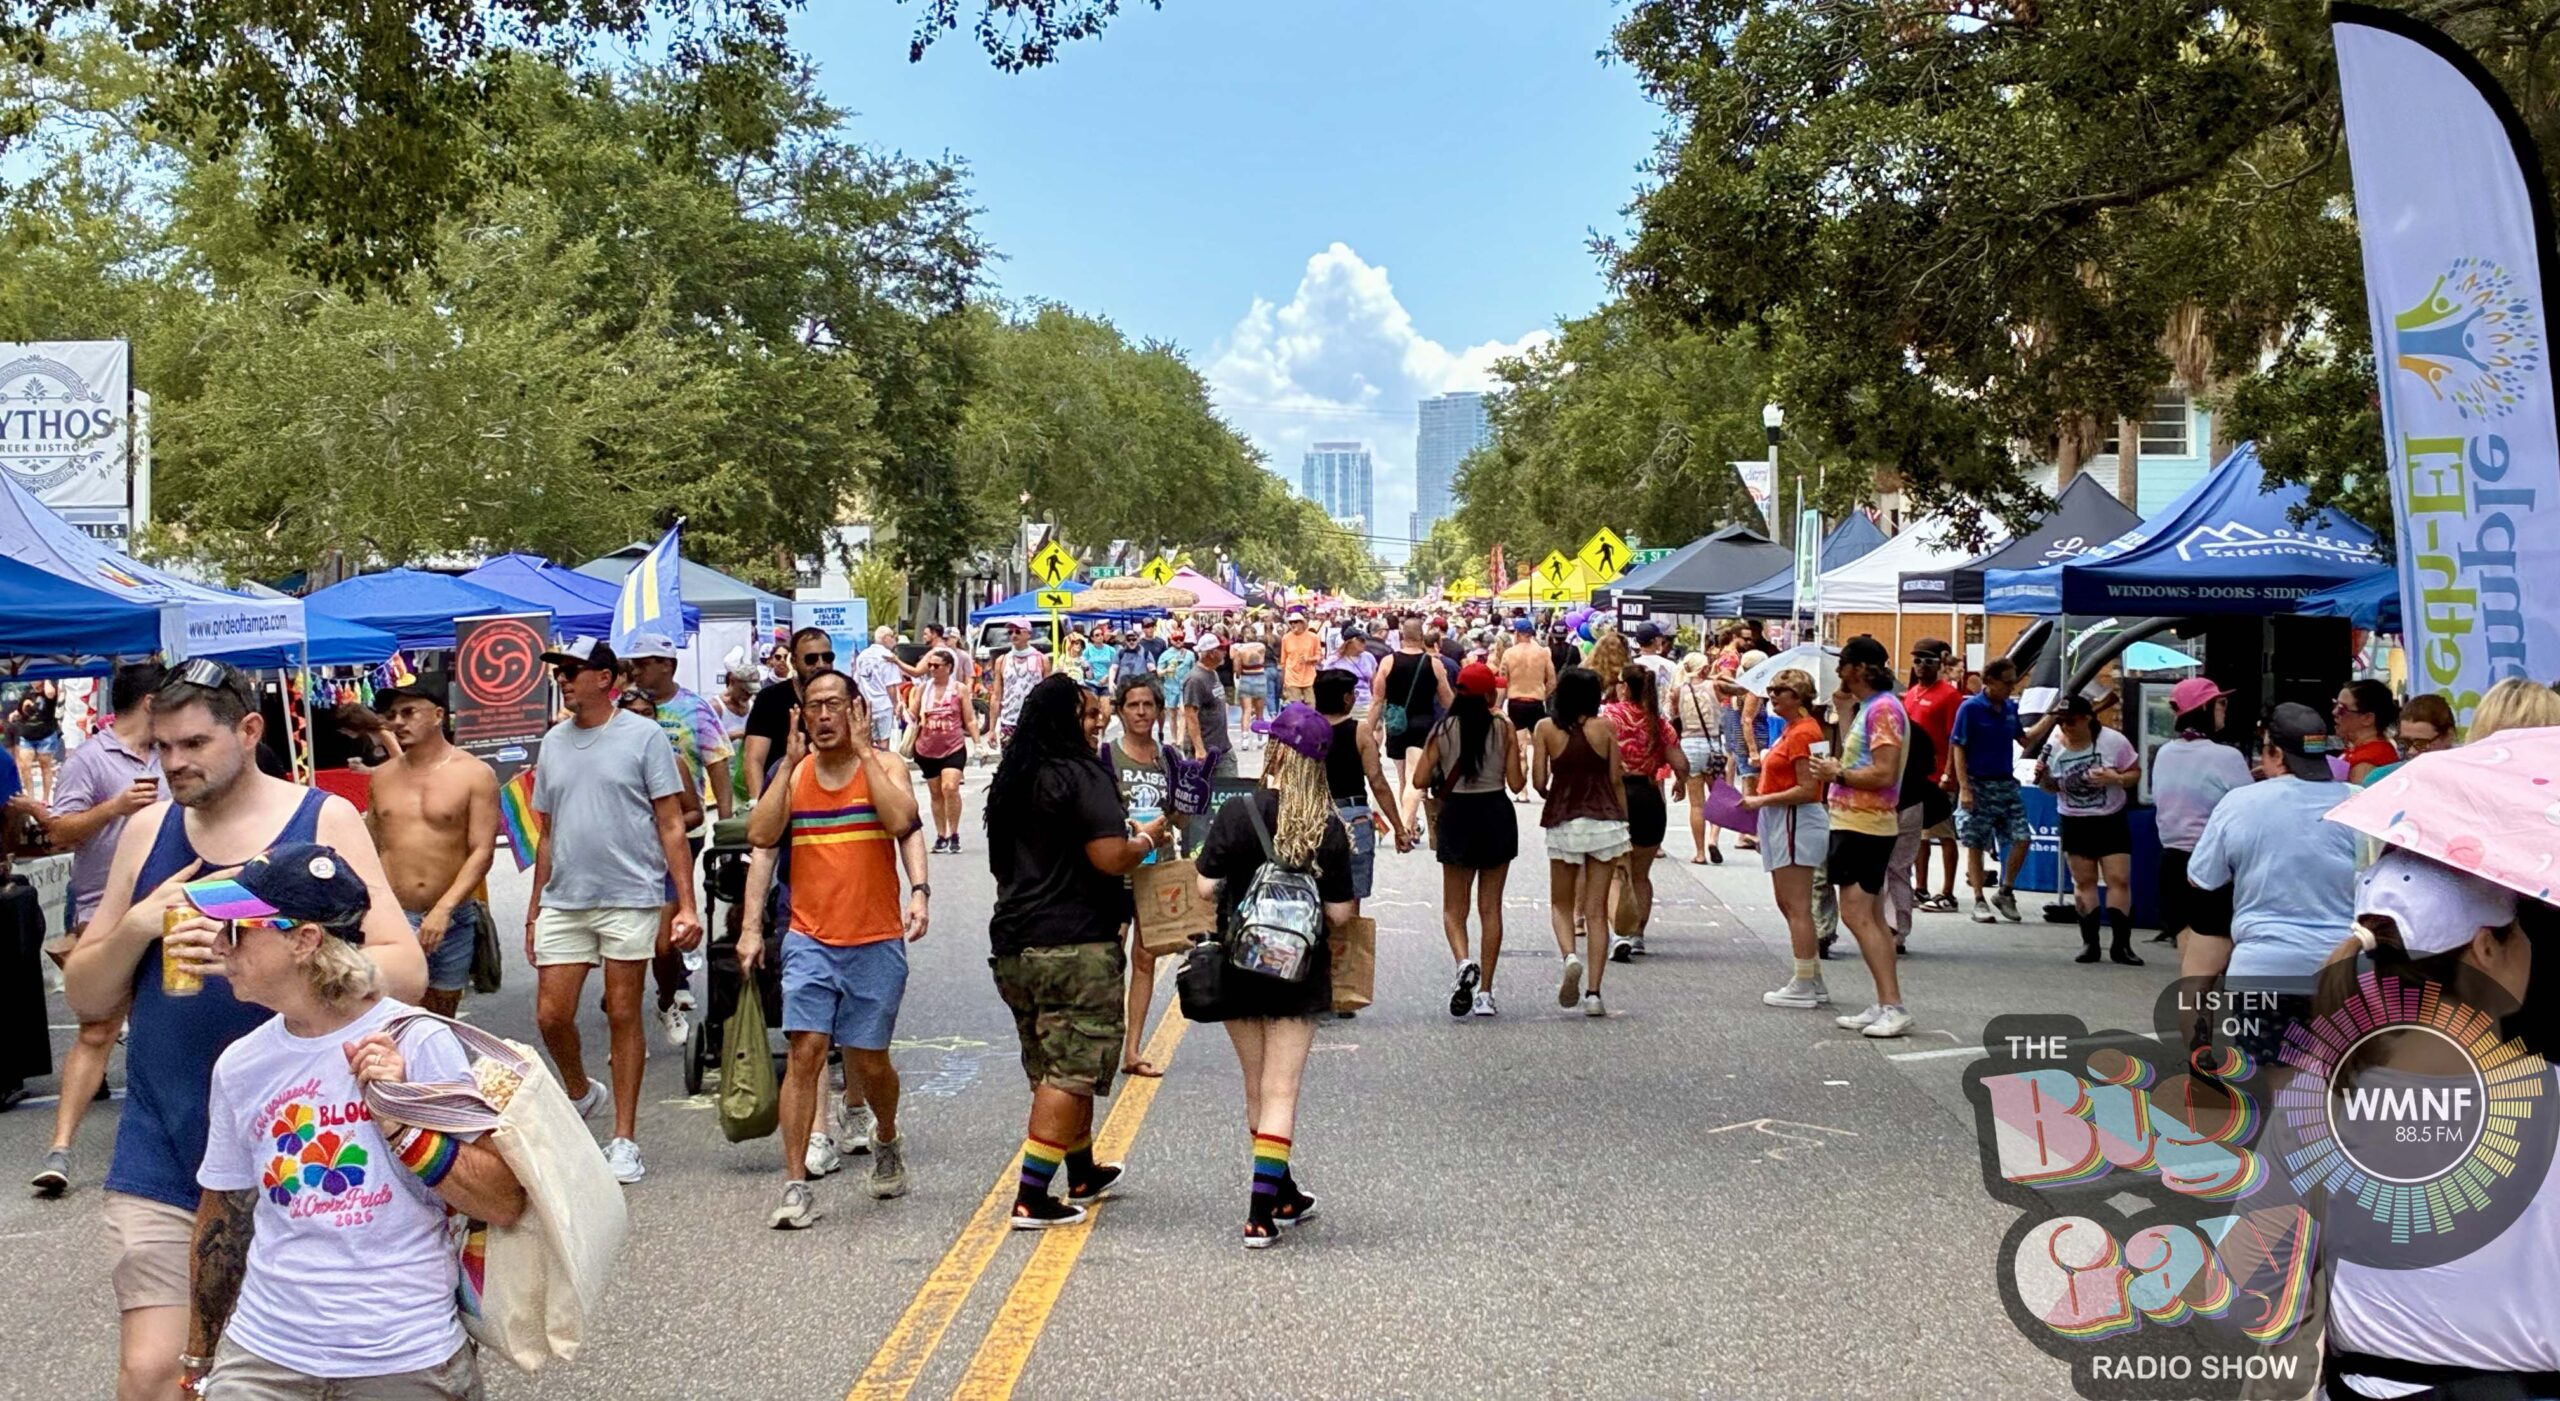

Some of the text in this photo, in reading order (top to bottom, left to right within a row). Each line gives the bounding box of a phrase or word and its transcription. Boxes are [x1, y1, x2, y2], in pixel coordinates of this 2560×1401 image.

[35, 443, 80, 453] BISTRO
[1632, 551, 1646, 562] 25
[2106, 584, 2190, 598] WINDOWS
[2198, 586, 2256, 599] DOORS
[188, 612, 289, 641] www.prideoftampa.com
[1174, 788, 1200, 803] GIRLS
[319, 1101, 373, 1127] BLOO
[344, 1183, 393, 1210] Pride
